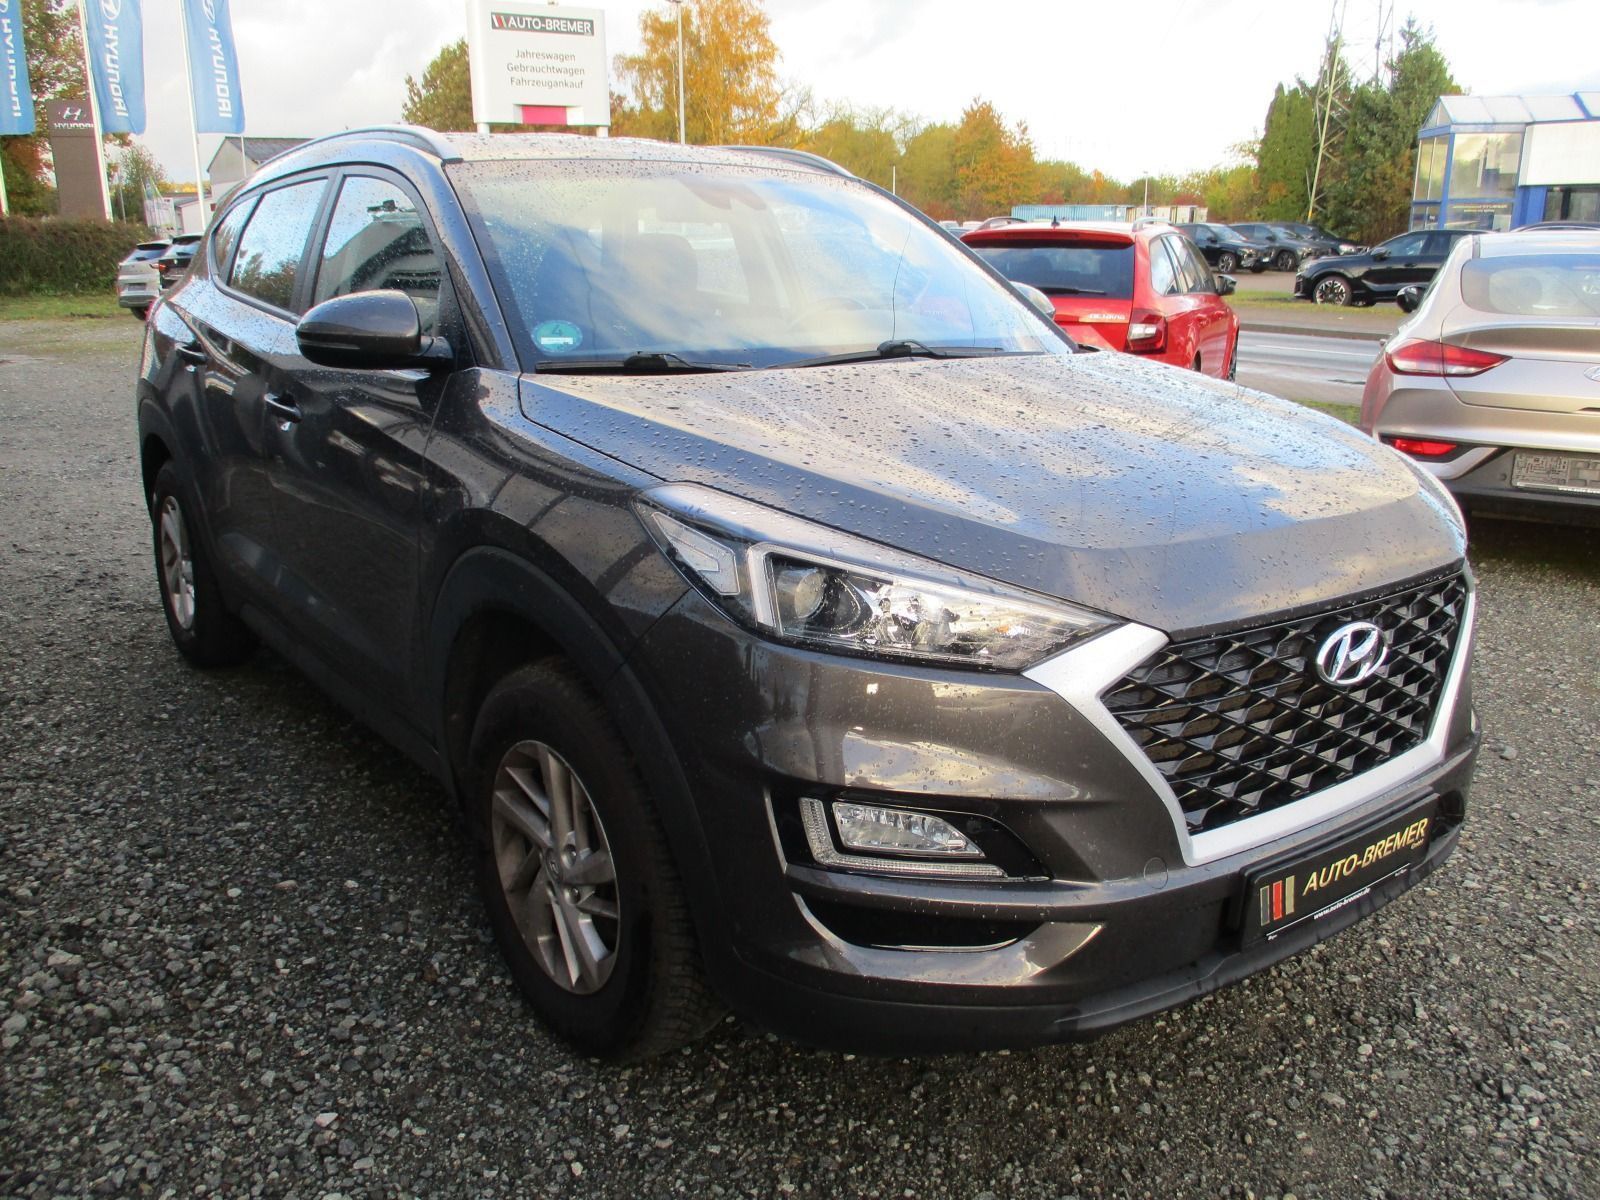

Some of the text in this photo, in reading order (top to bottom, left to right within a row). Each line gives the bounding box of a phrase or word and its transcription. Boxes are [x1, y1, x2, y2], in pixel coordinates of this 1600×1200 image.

[508, 16, 591, 33] AUTO-BREMER
[515, 49, 576, 62] Jahreswagen
[103, 24, 129, 117] HYUNDAI
[208, 27, 232, 118] HYUNDAI
[506, 62, 585, 76] Gebrauchtwagen
[510, 77, 583, 89] Fahrzeugankauf
[1302, 817, 1428, 896] AUTO-BREMER
